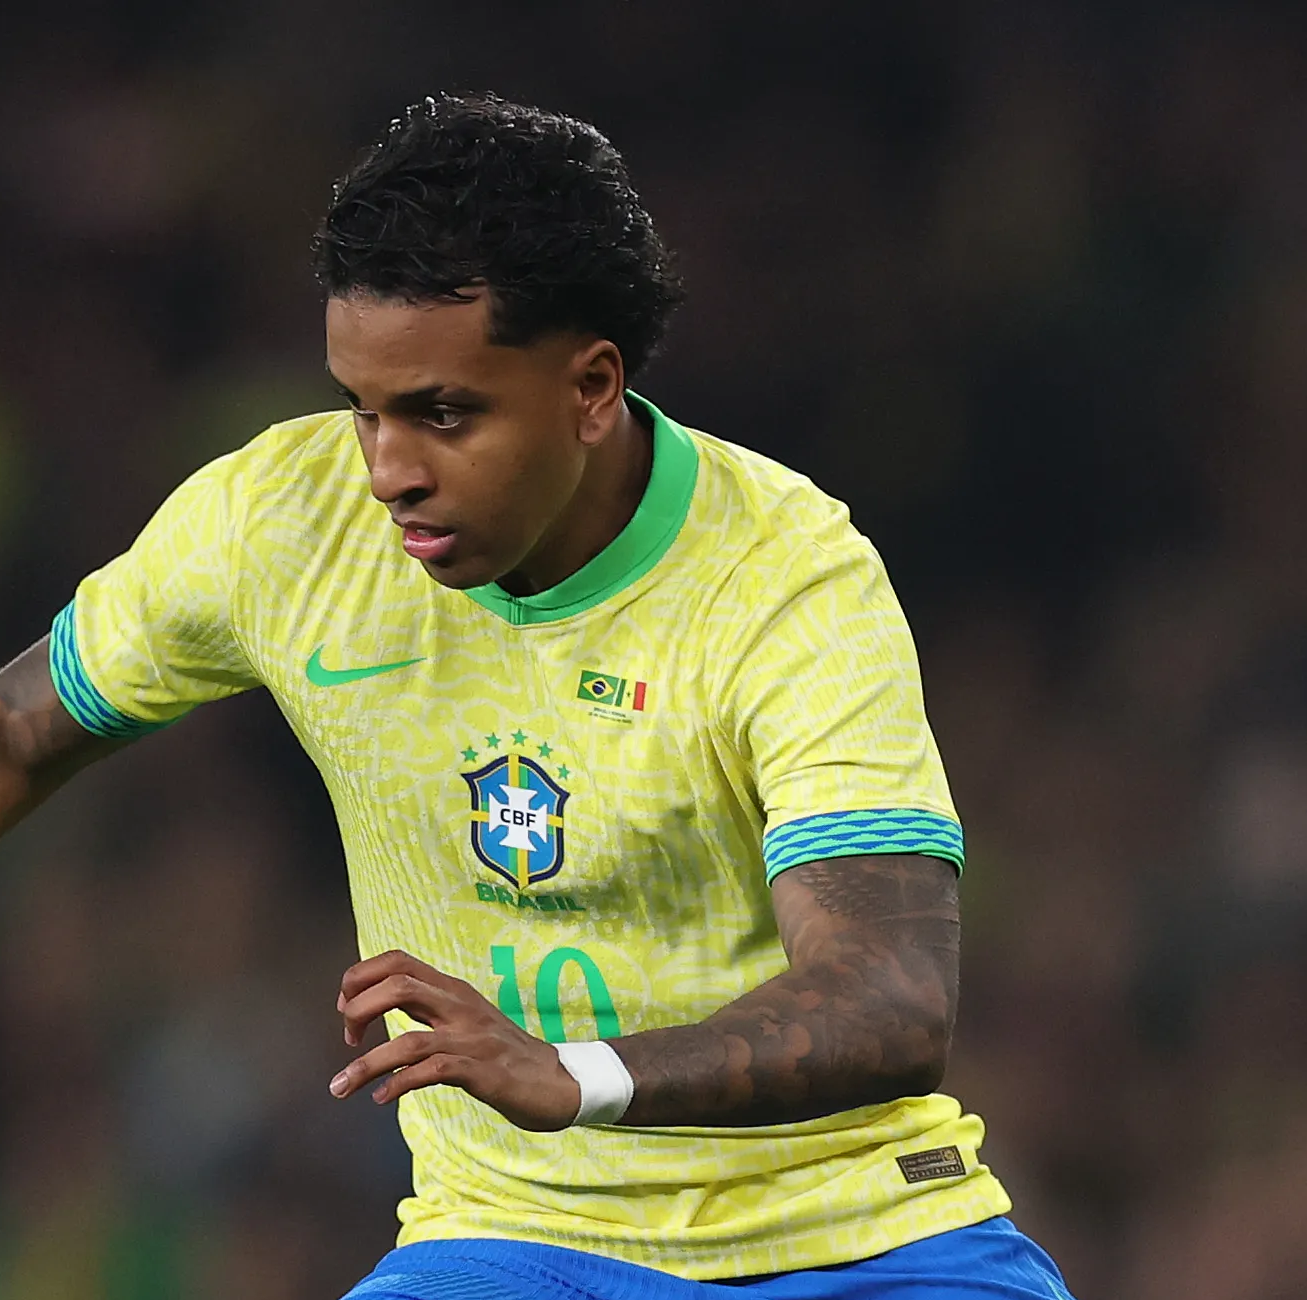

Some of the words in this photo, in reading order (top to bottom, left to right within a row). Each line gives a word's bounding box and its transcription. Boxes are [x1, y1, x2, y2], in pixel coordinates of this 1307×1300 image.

[500, 808, 537, 828] CBF
[476, 882, 587, 911] BRASIL
[490, 944, 622, 1044] 10
